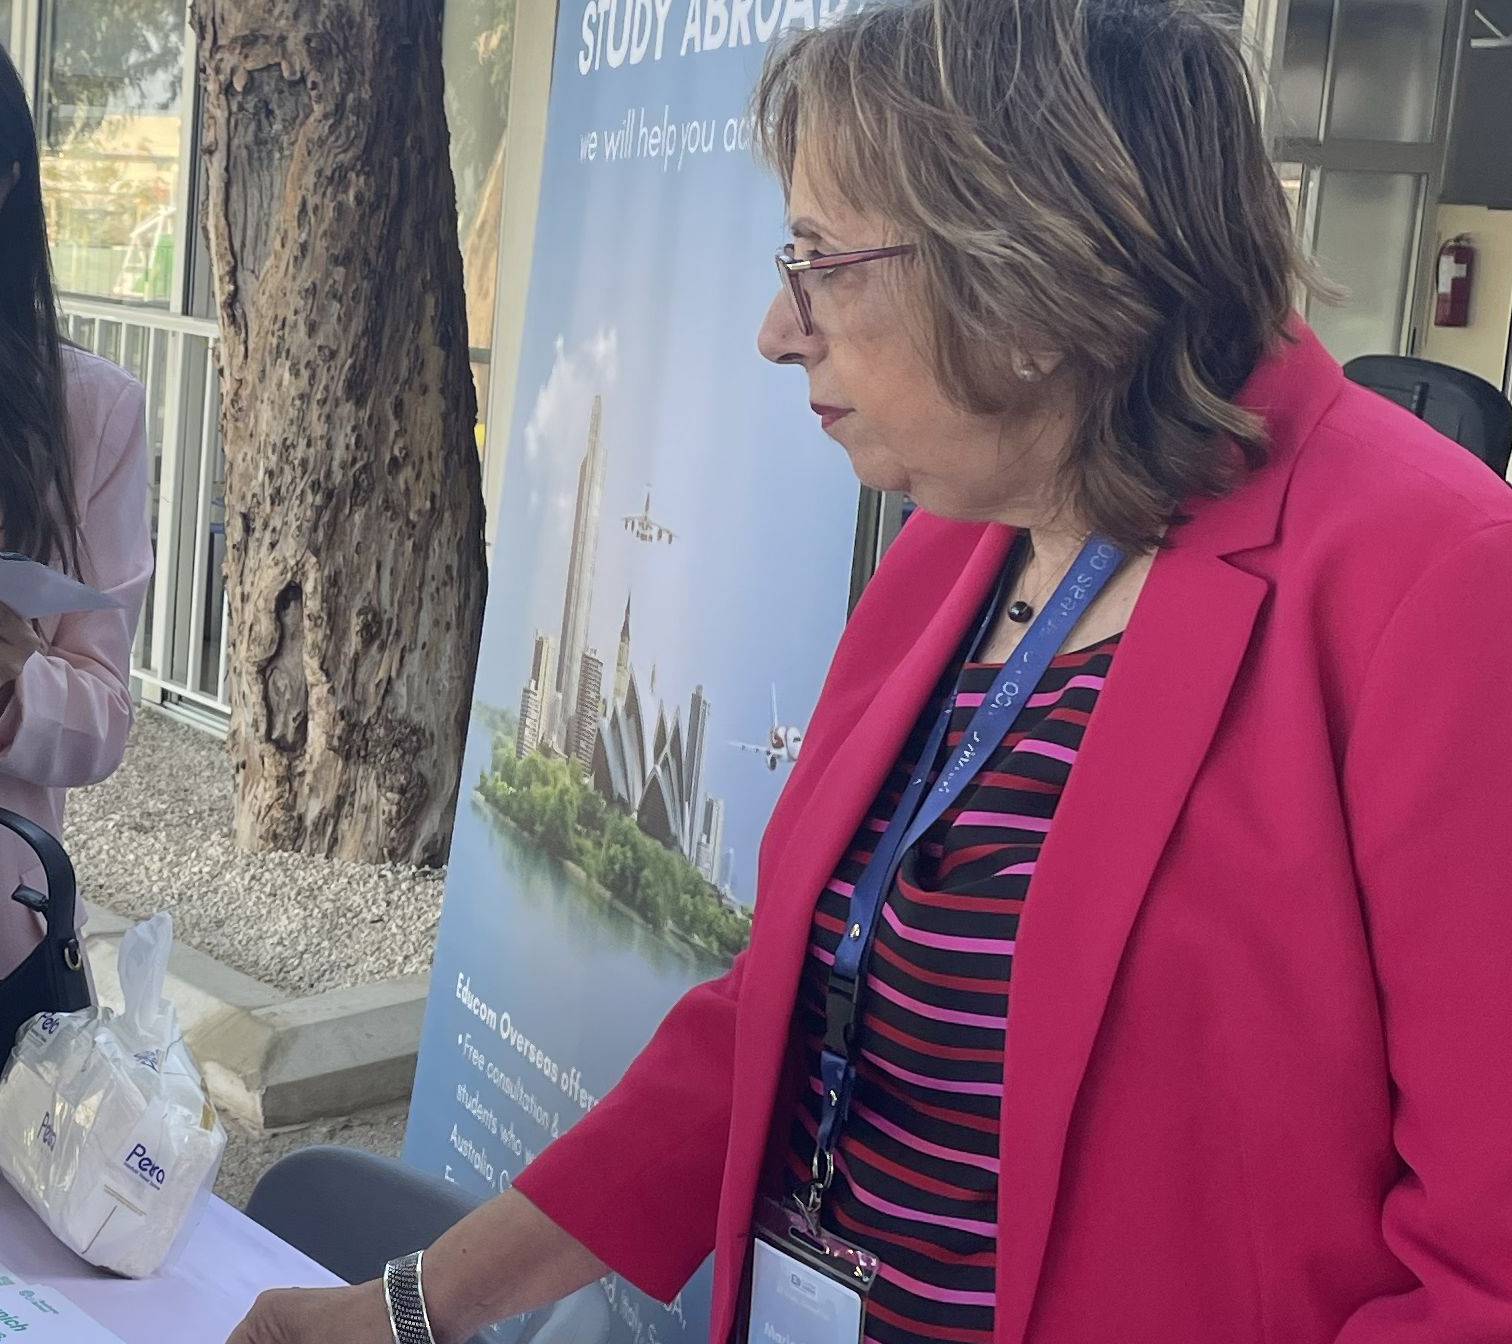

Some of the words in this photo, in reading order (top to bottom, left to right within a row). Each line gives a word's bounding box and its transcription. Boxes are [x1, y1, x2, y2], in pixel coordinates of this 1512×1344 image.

[579, 130, 597, 162] we
[604, 108, 635, 162] will
[638, 105, 677, 172] help
[678, 120, 716, 173] you
[455, 971, 497, 1031] Educom
[500, 1012, 559, 1083] Overseas
[456, 1084, 498, 1135] students
[463, 1033, 485, 1071] Free
[486, 1062, 549, 1131] consultation
[125, 1143, 166, 1185] Pera
[449, 1124, 496, 1189] Australia,
